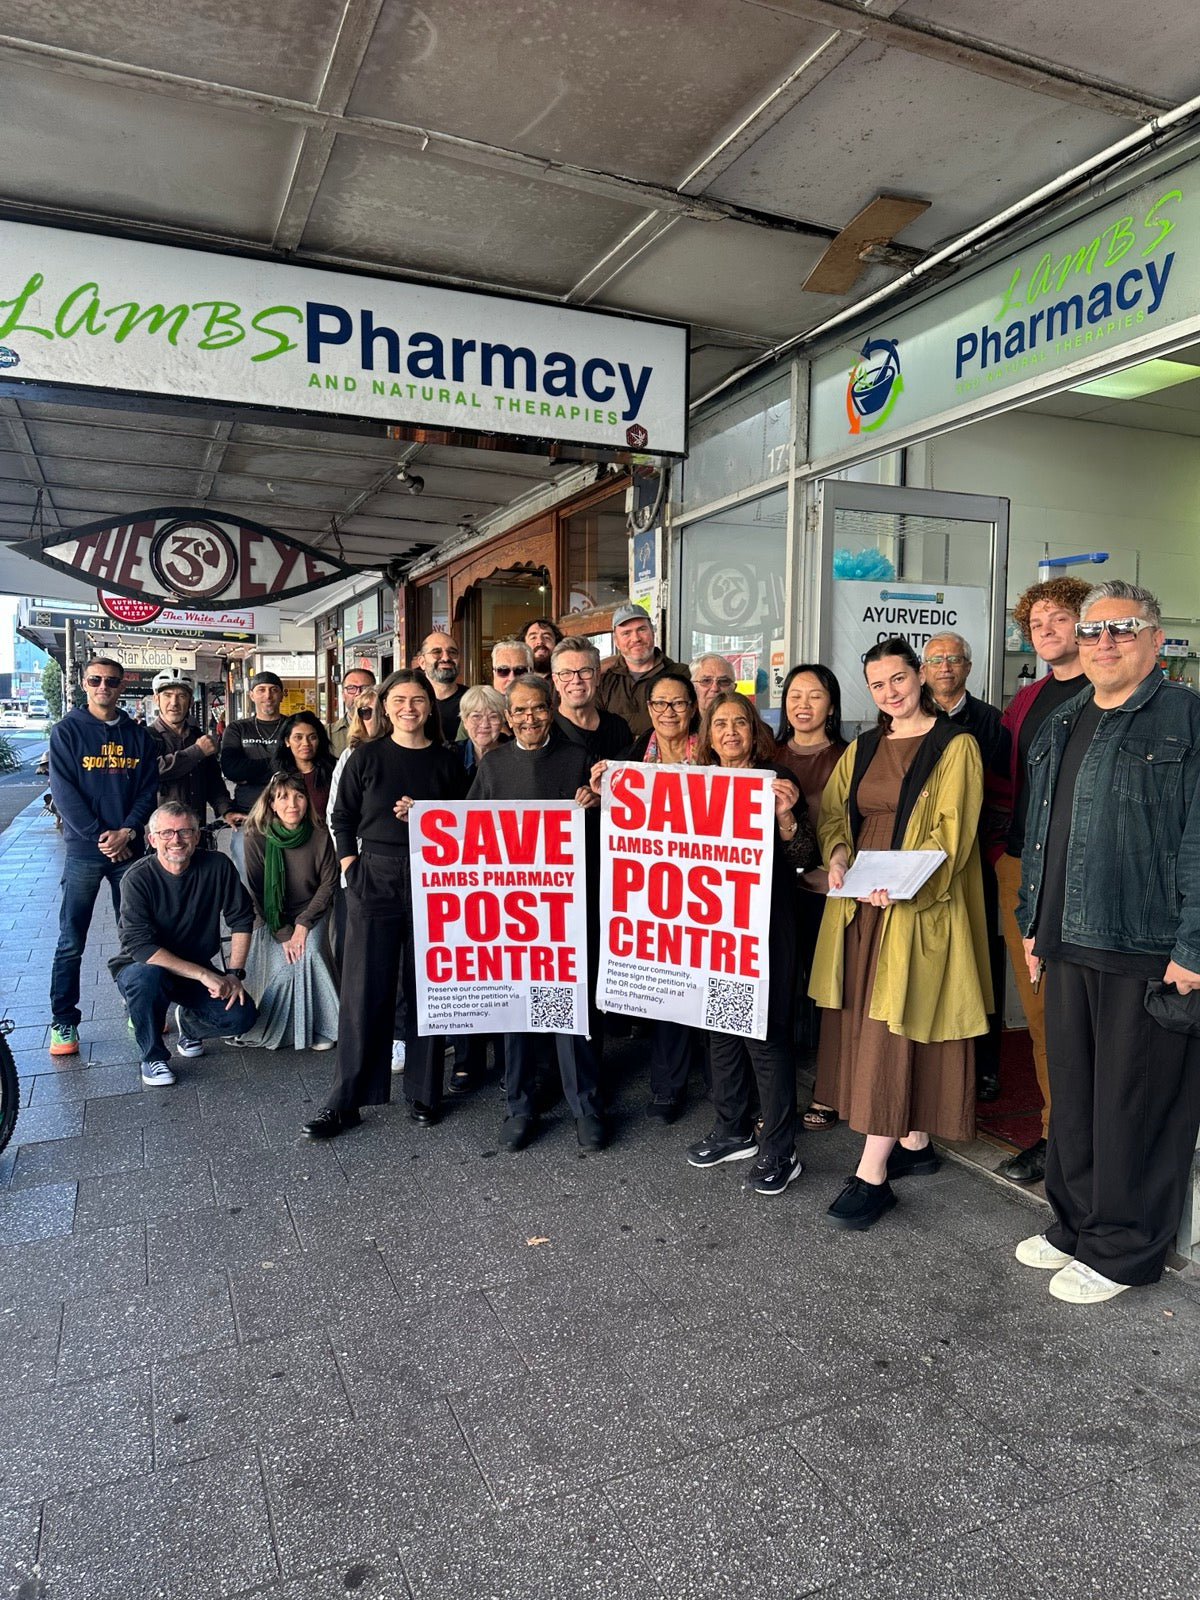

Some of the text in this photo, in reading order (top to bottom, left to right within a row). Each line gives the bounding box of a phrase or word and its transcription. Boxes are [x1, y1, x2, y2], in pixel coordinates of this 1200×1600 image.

[956, 252, 1177, 379] Pharmacy
[986, 353, 1047, 381] NATURAL
[1055, 310, 1145, 355] THERAPIES
[306, 301, 653, 421] Pharmacy
[309, 373, 619, 425] AND NATURAL THERAPIES
[71, 520, 157, 591] THE
[239, 526, 326, 598] EYE
[88, 618, 106, 629] ST.
[162, 611, 246, 626] The White Lady
[862, 606, 958, 626] AYURVEDIC
[877, 631, 932, 648] CENTR
[117, 648, 173, 666] Star Kebab
[101, 741, 124, 755] nike
[82, 755, 140, 771] sportswer
[610, 767, 764, 841] SAVE
[419, 808, 574, 867] SAVE
[608, 835, 764, 866] LAMBS PHARMACY
[422, 871, 575, 888] LAMBS PHARMACY
[612, 857, 761, 930] POST
[426, 890, 574, 943] POST
[608, 916, 761, 978] CENTRE
[426, 945, 578, 983] CENTRE
[608, 960, 636, 969] Preserve
[651, 967, 692, 979] community.
[607, 969, 629, 977] Please
[630, 973, 644, 981] sign
[658, 977, 685, 987] petition
[605, 988, 664, 1004] Lambs Pharmacy.
[605, 1000, 647, 1013] Many thanks
